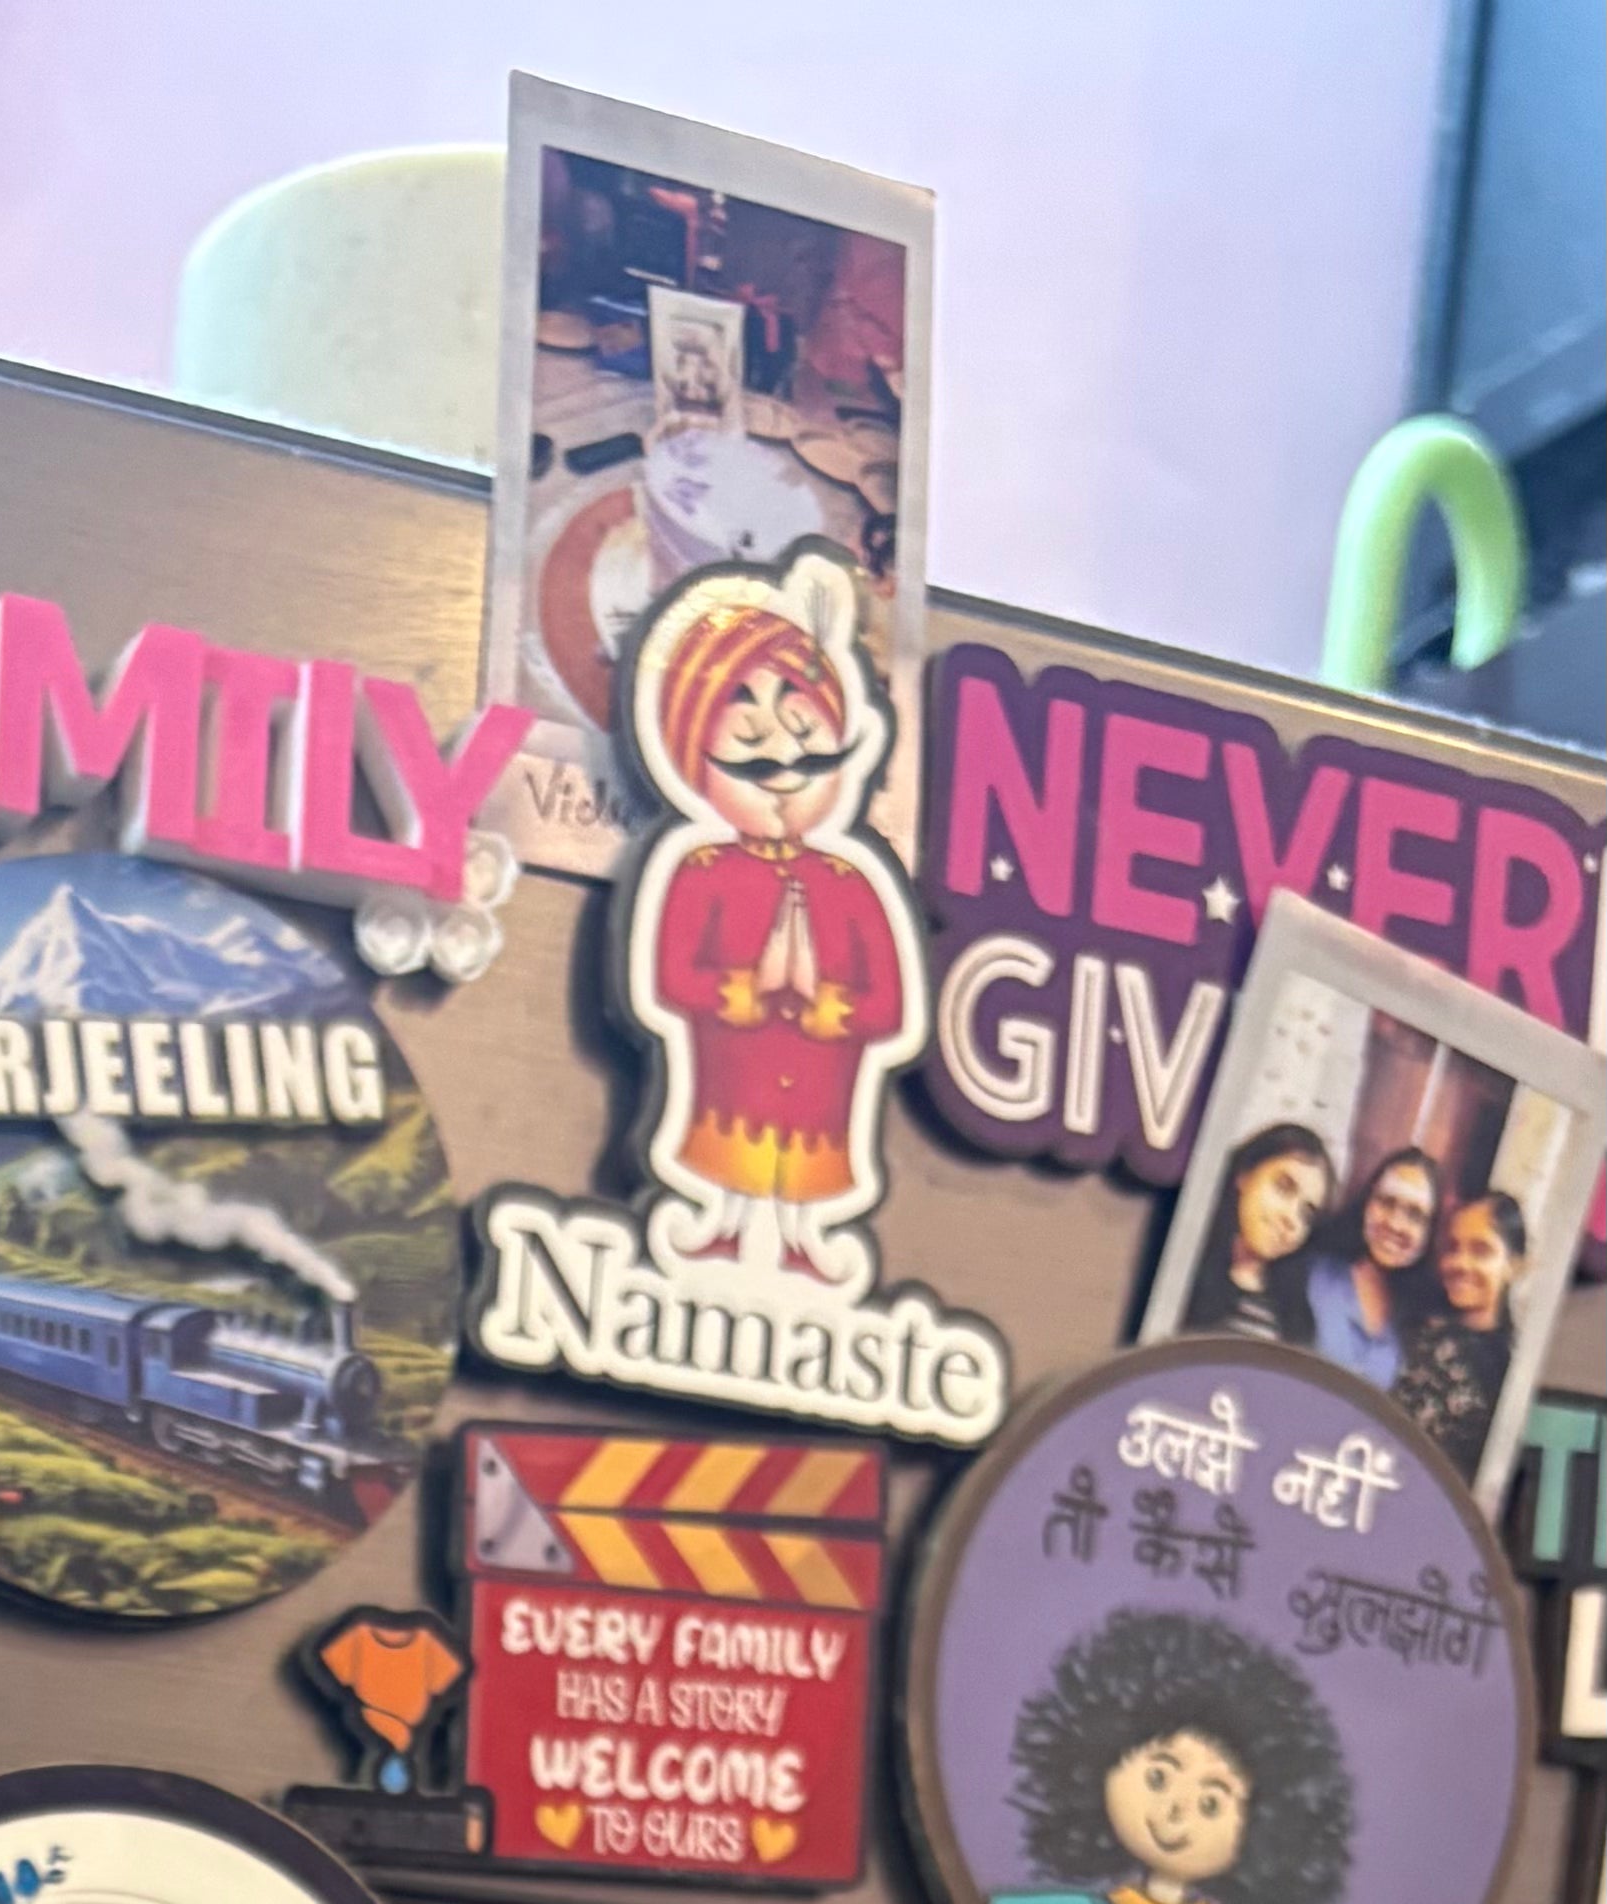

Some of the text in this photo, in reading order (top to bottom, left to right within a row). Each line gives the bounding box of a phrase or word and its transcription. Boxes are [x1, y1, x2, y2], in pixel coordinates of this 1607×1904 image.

[946, 676, 1585, 1032] NEVER
[938, 936, 1226, 1150] GIV
[506, 1229, 986, 1420] Namaste
[1118, 1391, 1402, 1534] उलझे नहीं
[1042, 1465, 1108, 1563] तो
[1130, 1485, 1257, 1600] कैसे
[501, 1601, 848, 1682] EVERY FAMILY
[556, 1669, 789, 1738] HAS A STORY
[529, 1734, 806, 1814] WELCOME
[586, 1804, 744, 1863] TO OURS
